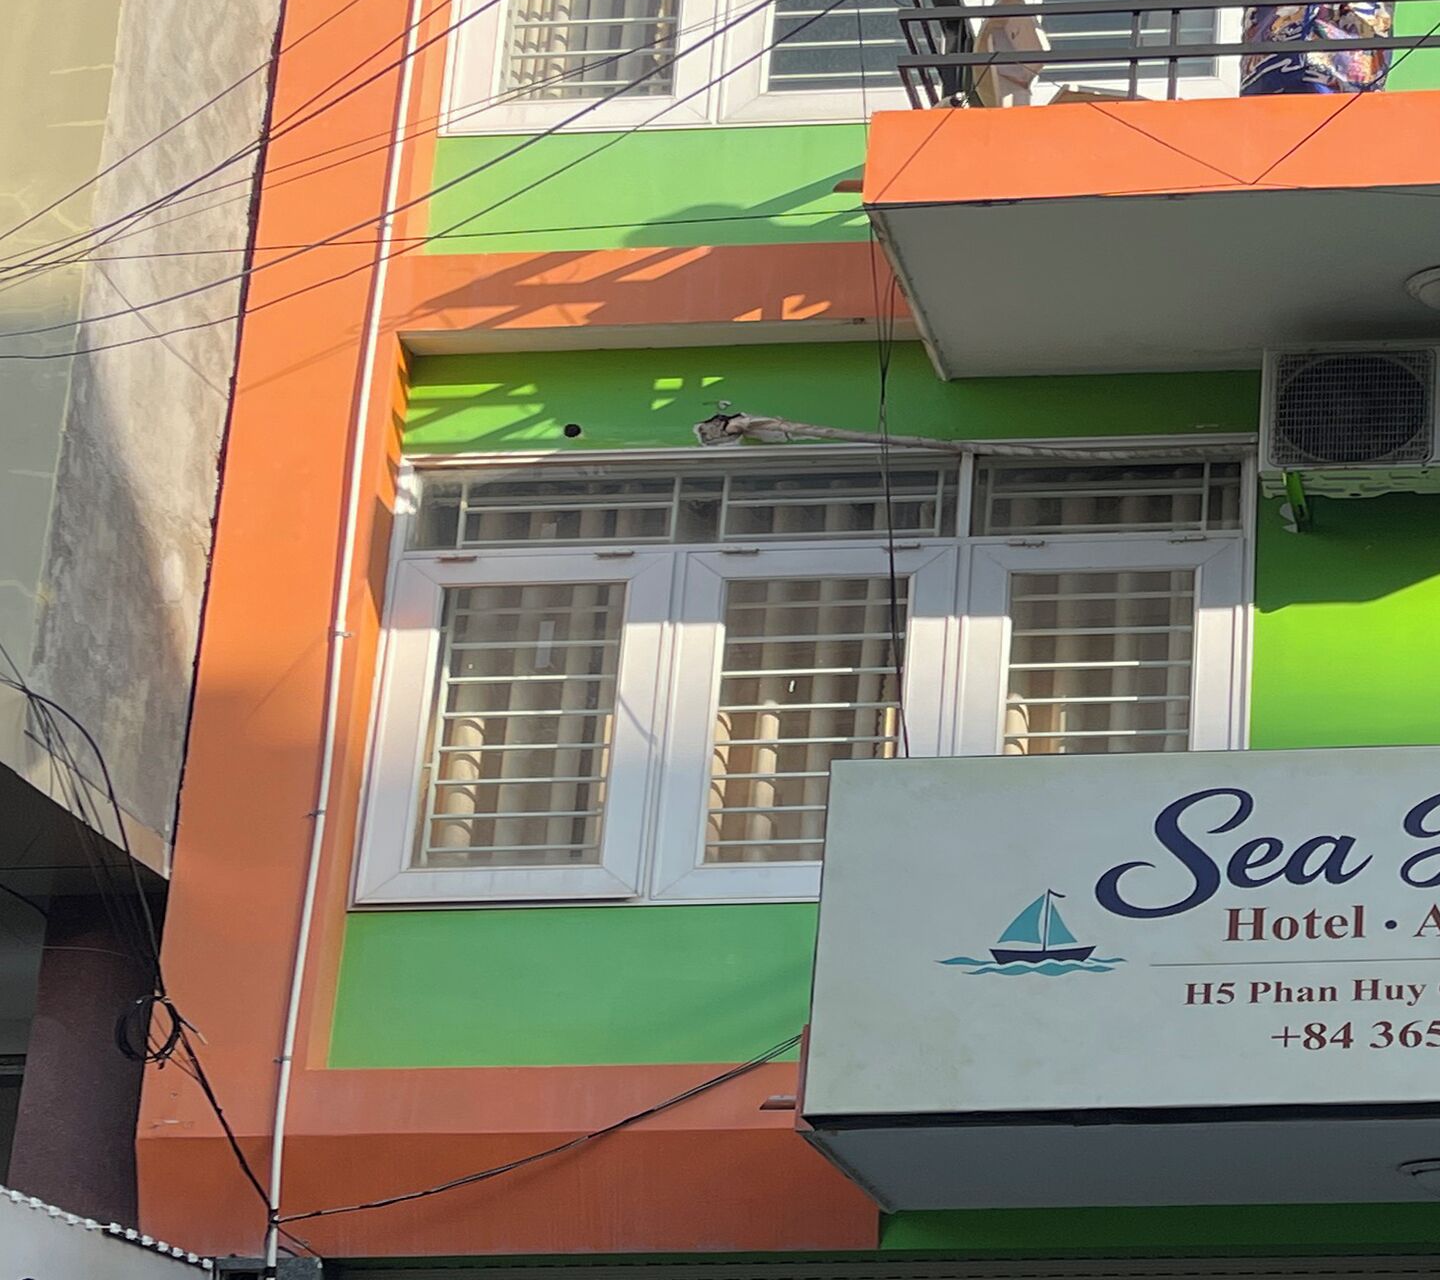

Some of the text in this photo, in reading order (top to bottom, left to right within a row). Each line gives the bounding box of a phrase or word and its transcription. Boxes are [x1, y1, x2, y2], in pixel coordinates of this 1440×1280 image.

[1095, 787, 1374, 919] Sea
[1222, 905, 1366, 942] Hotel
[1184, 982, 1236, 1005] H5
[1249, 981, 1338, 1004] Phan
[1352, 978, 1427, 1006] Huy
[1271, 1022, 1354, 1050] +84
